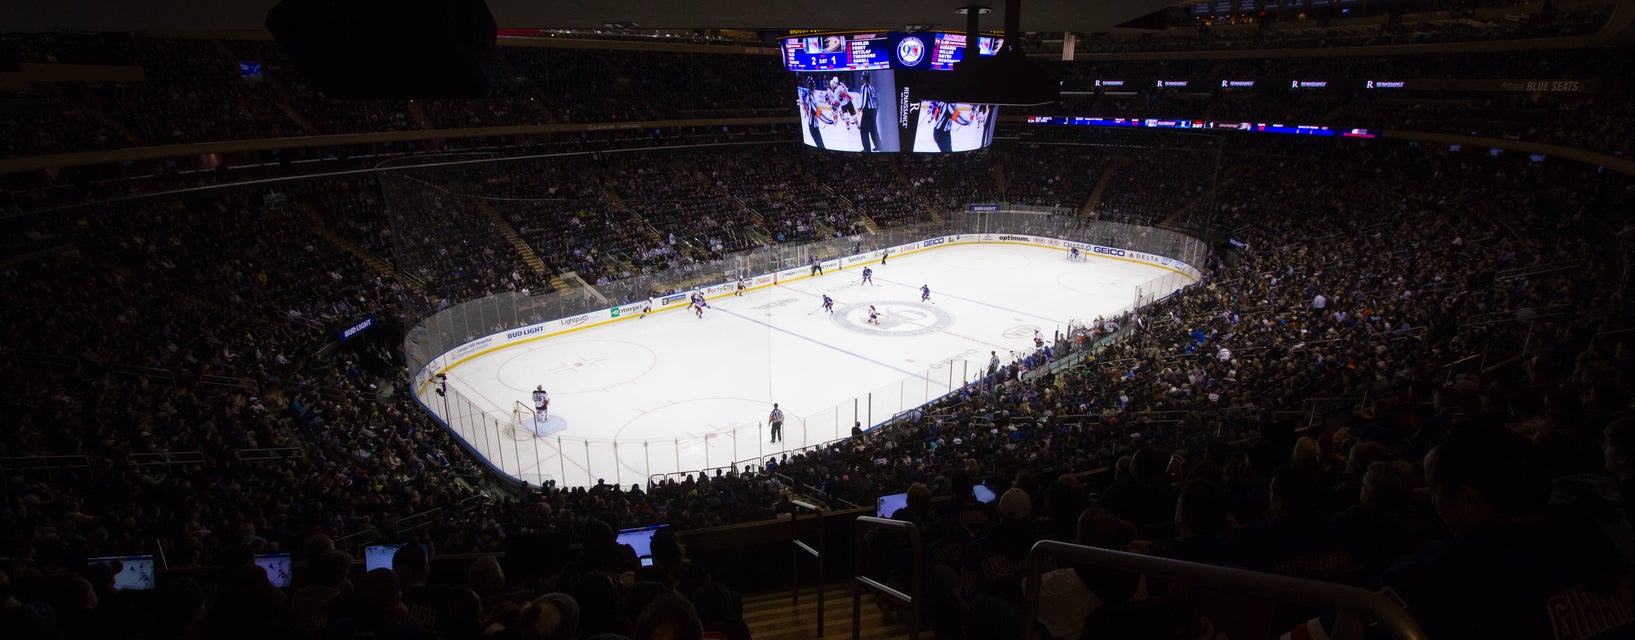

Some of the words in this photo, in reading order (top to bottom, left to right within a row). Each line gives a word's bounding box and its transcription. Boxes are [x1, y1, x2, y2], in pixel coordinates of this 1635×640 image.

[811, 56, 817, 65] 2
[831, 56, 836, 65] 1
[1527, 81, 1549, 91] BLUE
[1551, 81, 1579, 91] SEATS
[910, 102, 920, 113] R
[923, 237, 945, 247] GEICO
[1093, 246, 1125, 257] GEICO
[1136, 252, 1159, 262] DELTA
[344, 327, 356, 337] BUD
[356, 318, 371, 331] LIGHT
[507, 330, 523, 339] BUD
[523, 326, 545, 336] LIGHT
